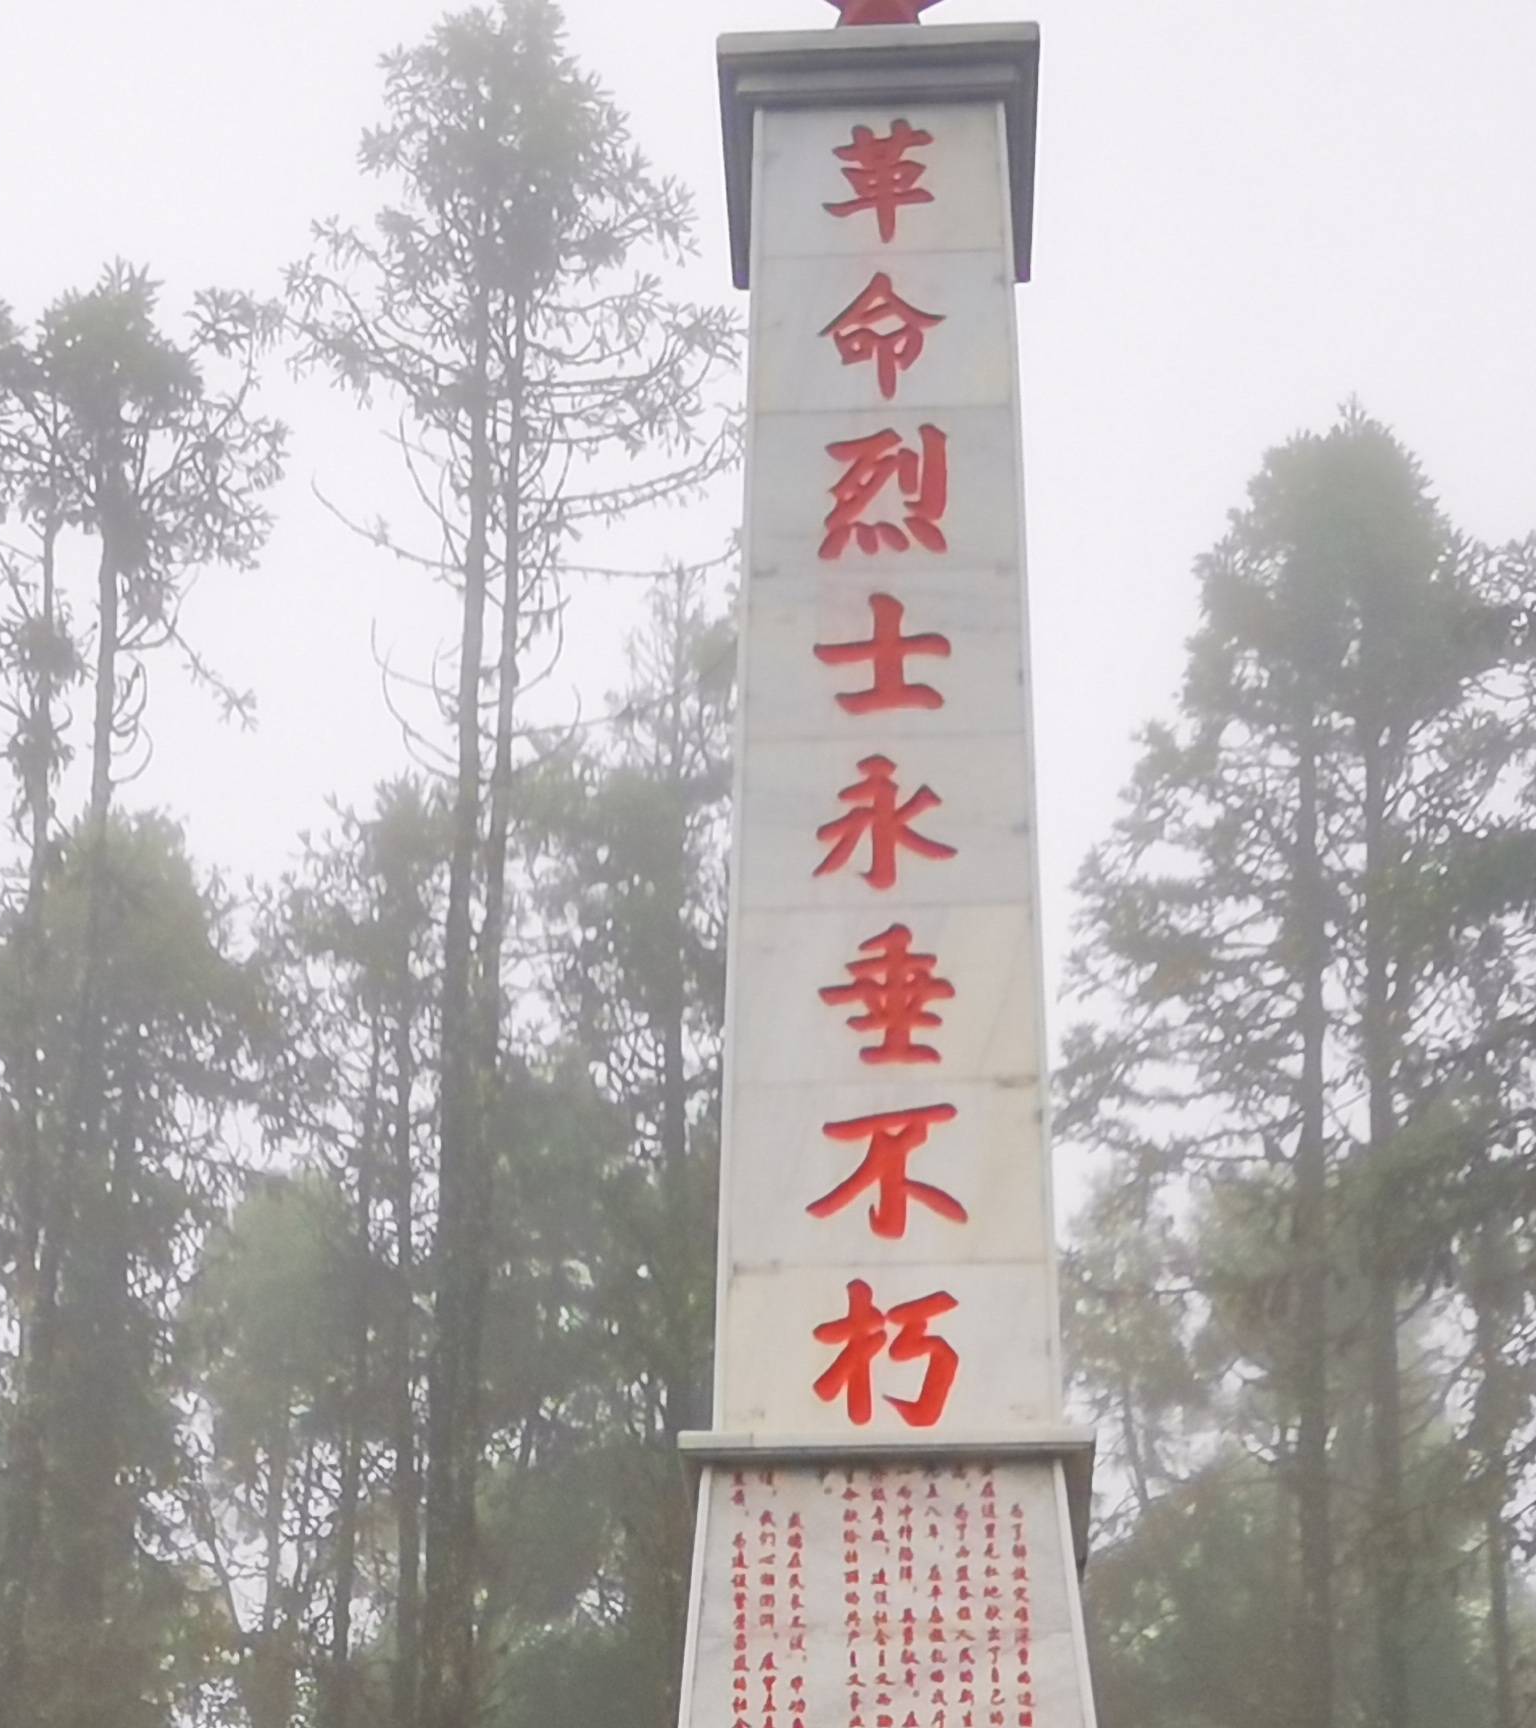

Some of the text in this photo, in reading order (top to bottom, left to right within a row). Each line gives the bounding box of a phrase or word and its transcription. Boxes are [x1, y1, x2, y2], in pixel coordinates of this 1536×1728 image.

[805, 118, 969, 1427] 革命烈士永垂不朽
